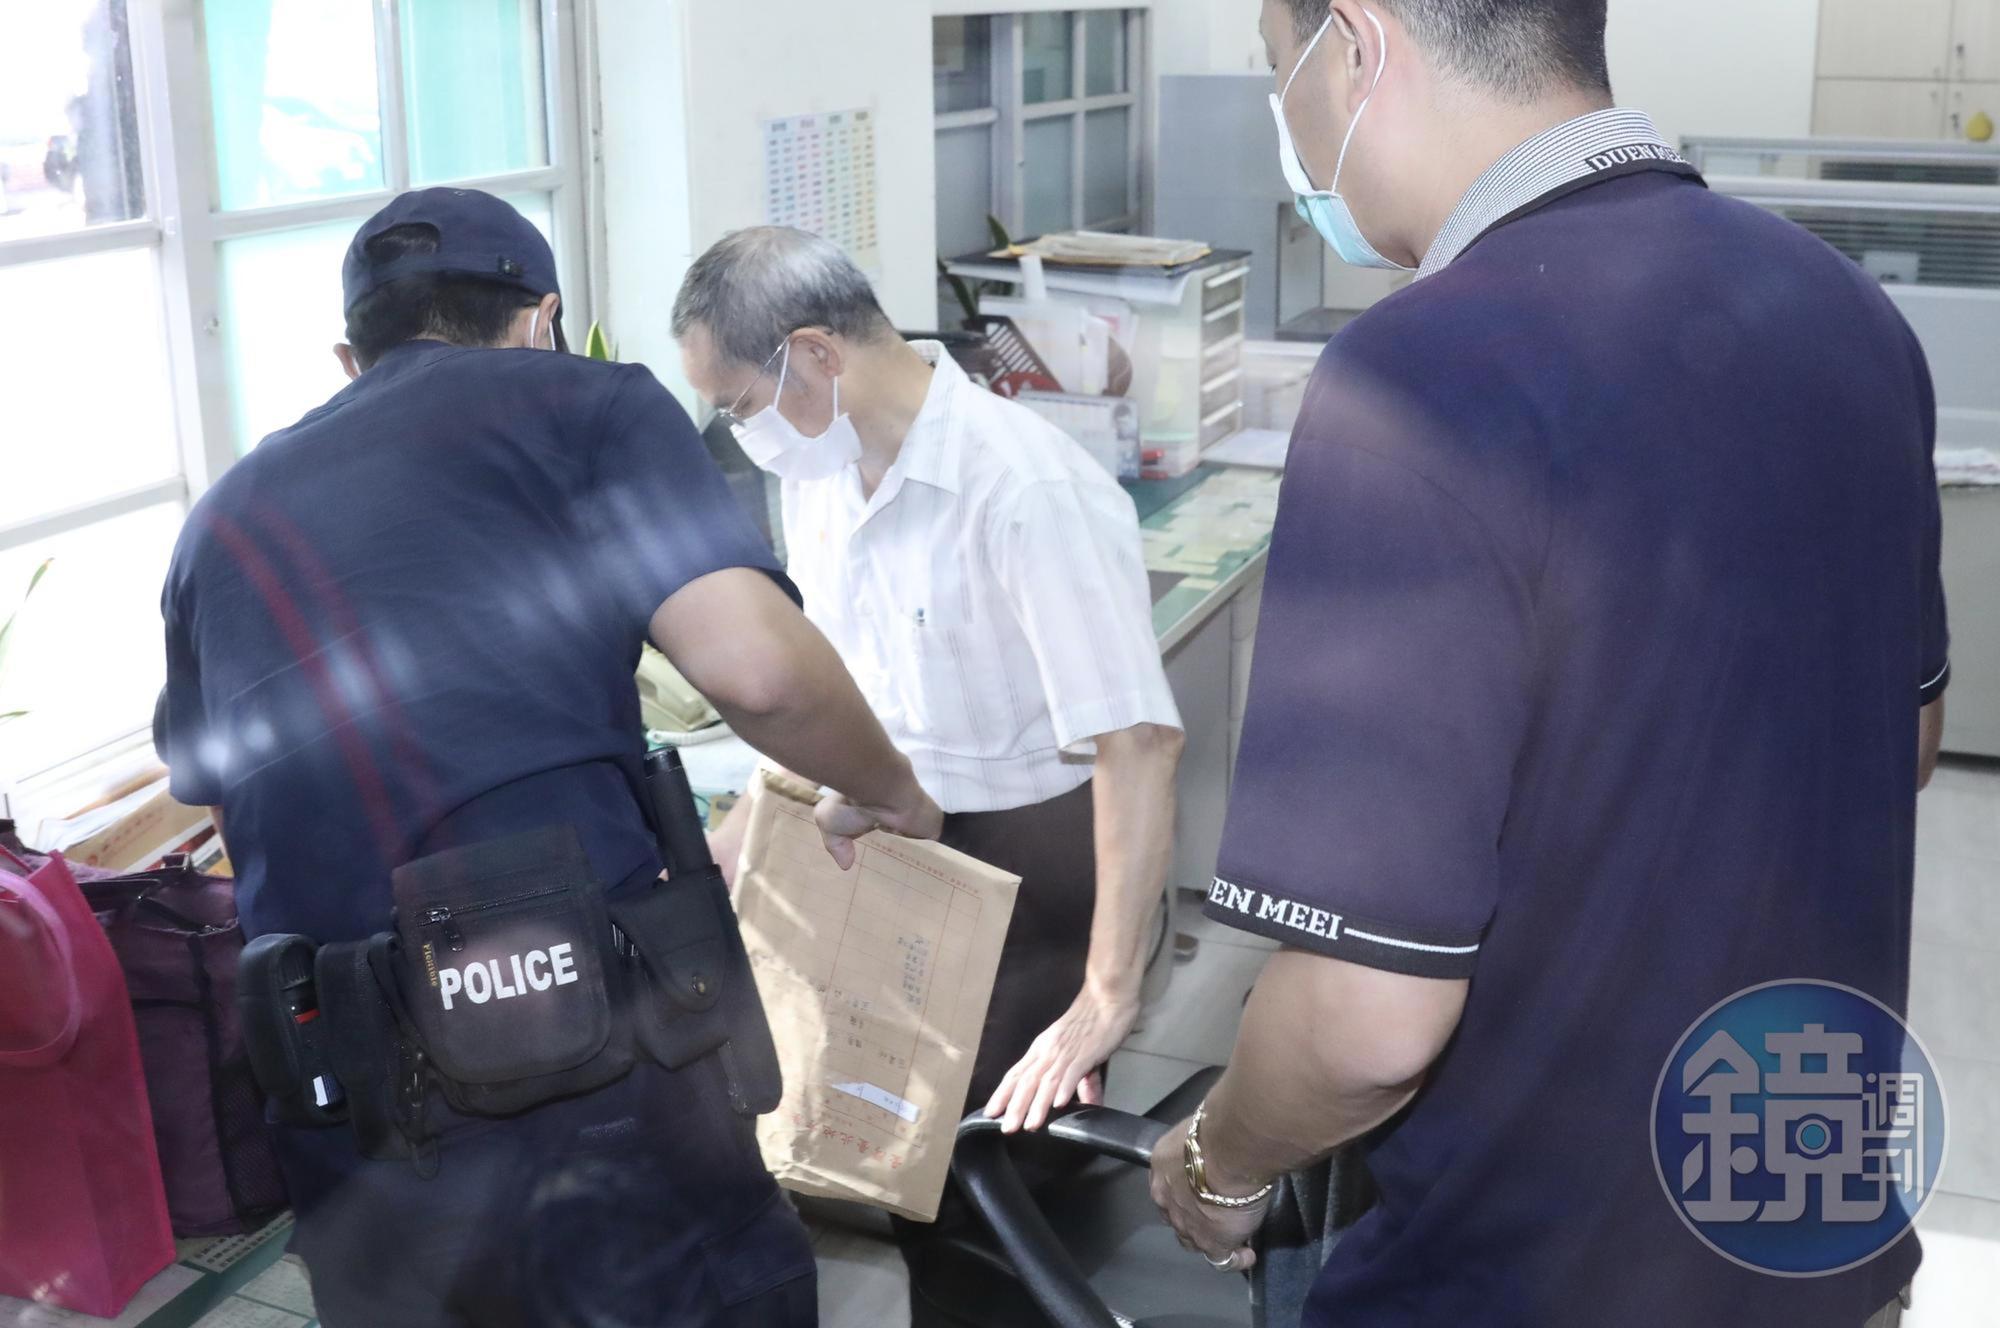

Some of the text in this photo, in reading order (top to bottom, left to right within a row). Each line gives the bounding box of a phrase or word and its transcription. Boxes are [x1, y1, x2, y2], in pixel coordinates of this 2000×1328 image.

[1588, 144, 1658, 171] DUEN
[1208, 876, 1343, 940] EN MEEI
[438, 942, 578, 1011] POLICE
